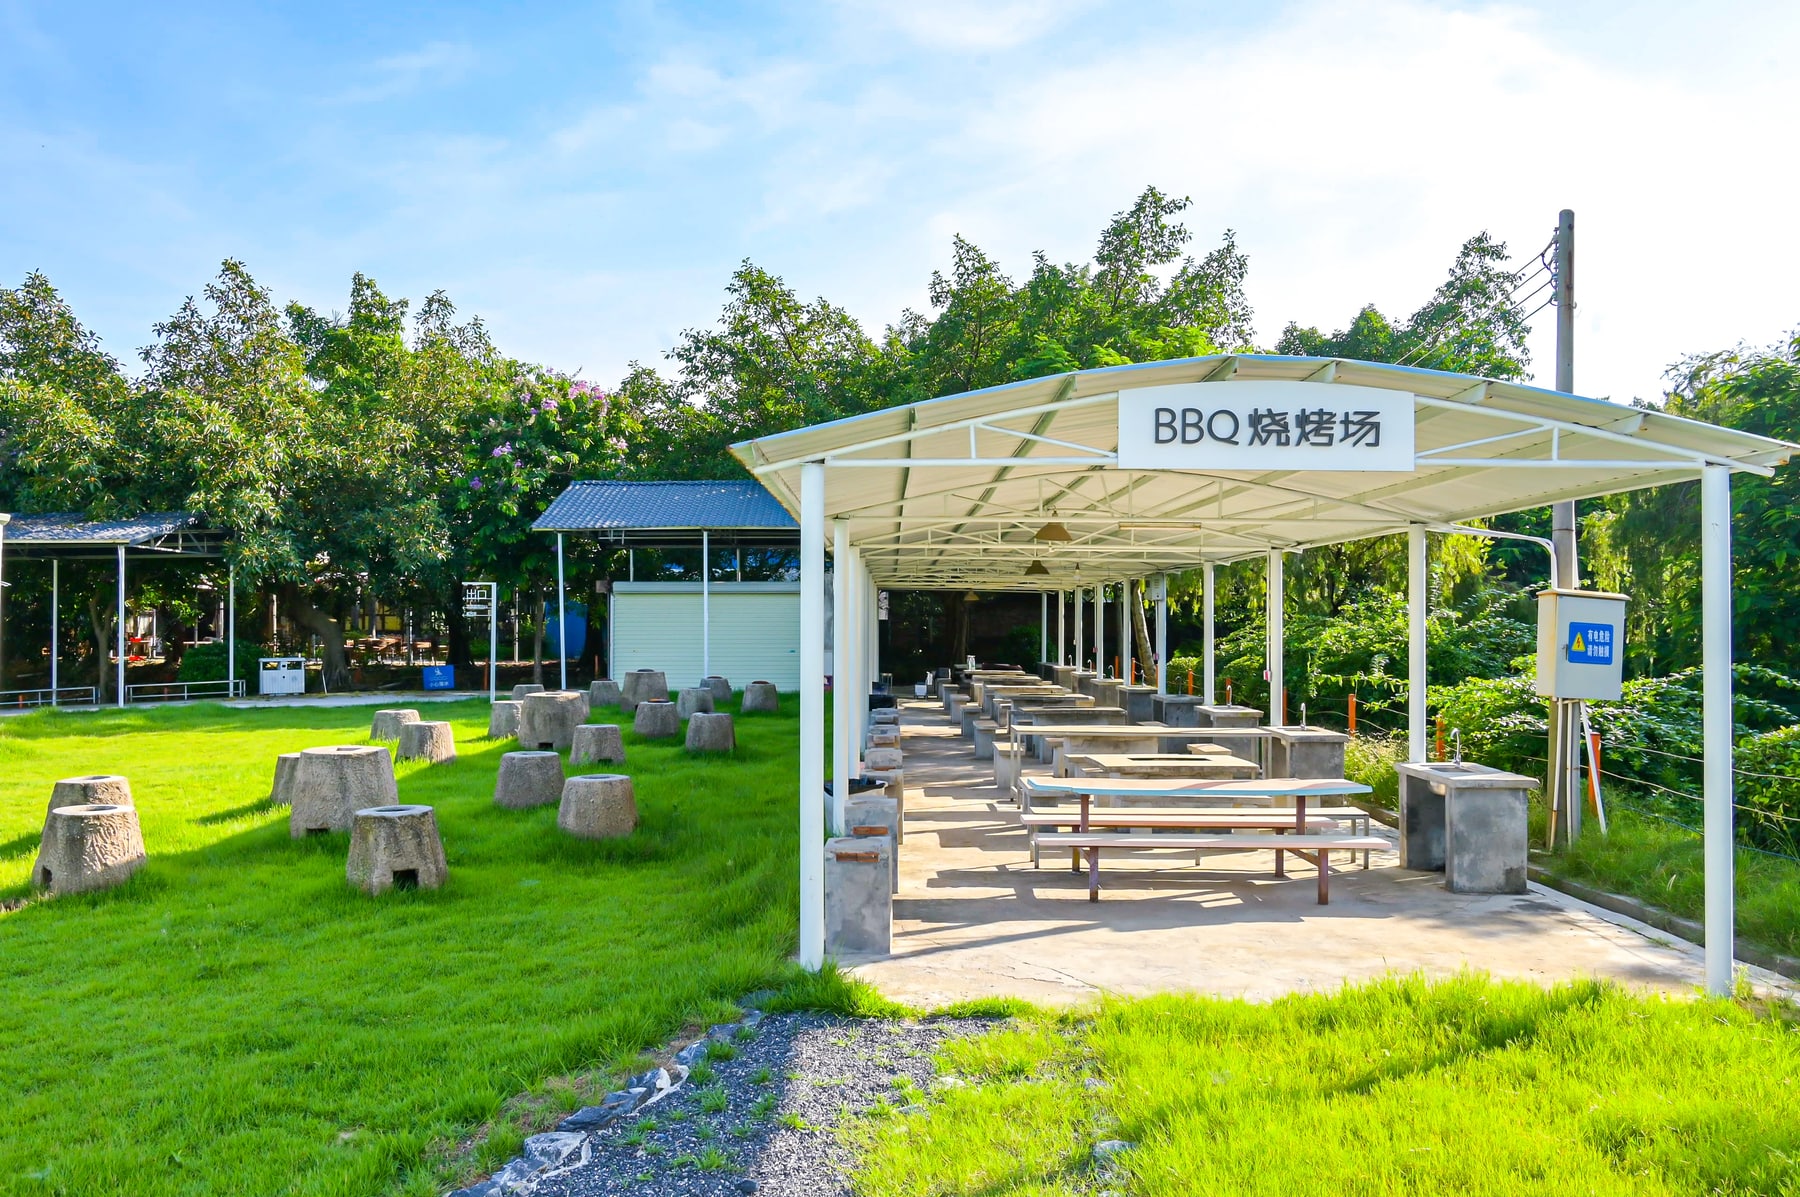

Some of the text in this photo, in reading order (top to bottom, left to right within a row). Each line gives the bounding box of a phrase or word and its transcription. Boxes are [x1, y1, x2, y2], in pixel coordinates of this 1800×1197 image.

[1154, 408, 1239, 445] BBQ
[1248, 408, 1380, 447] 烧烤场
[466, 589, 487, 601] 出口
[1587, 629, 1610, 643] 有电危险
